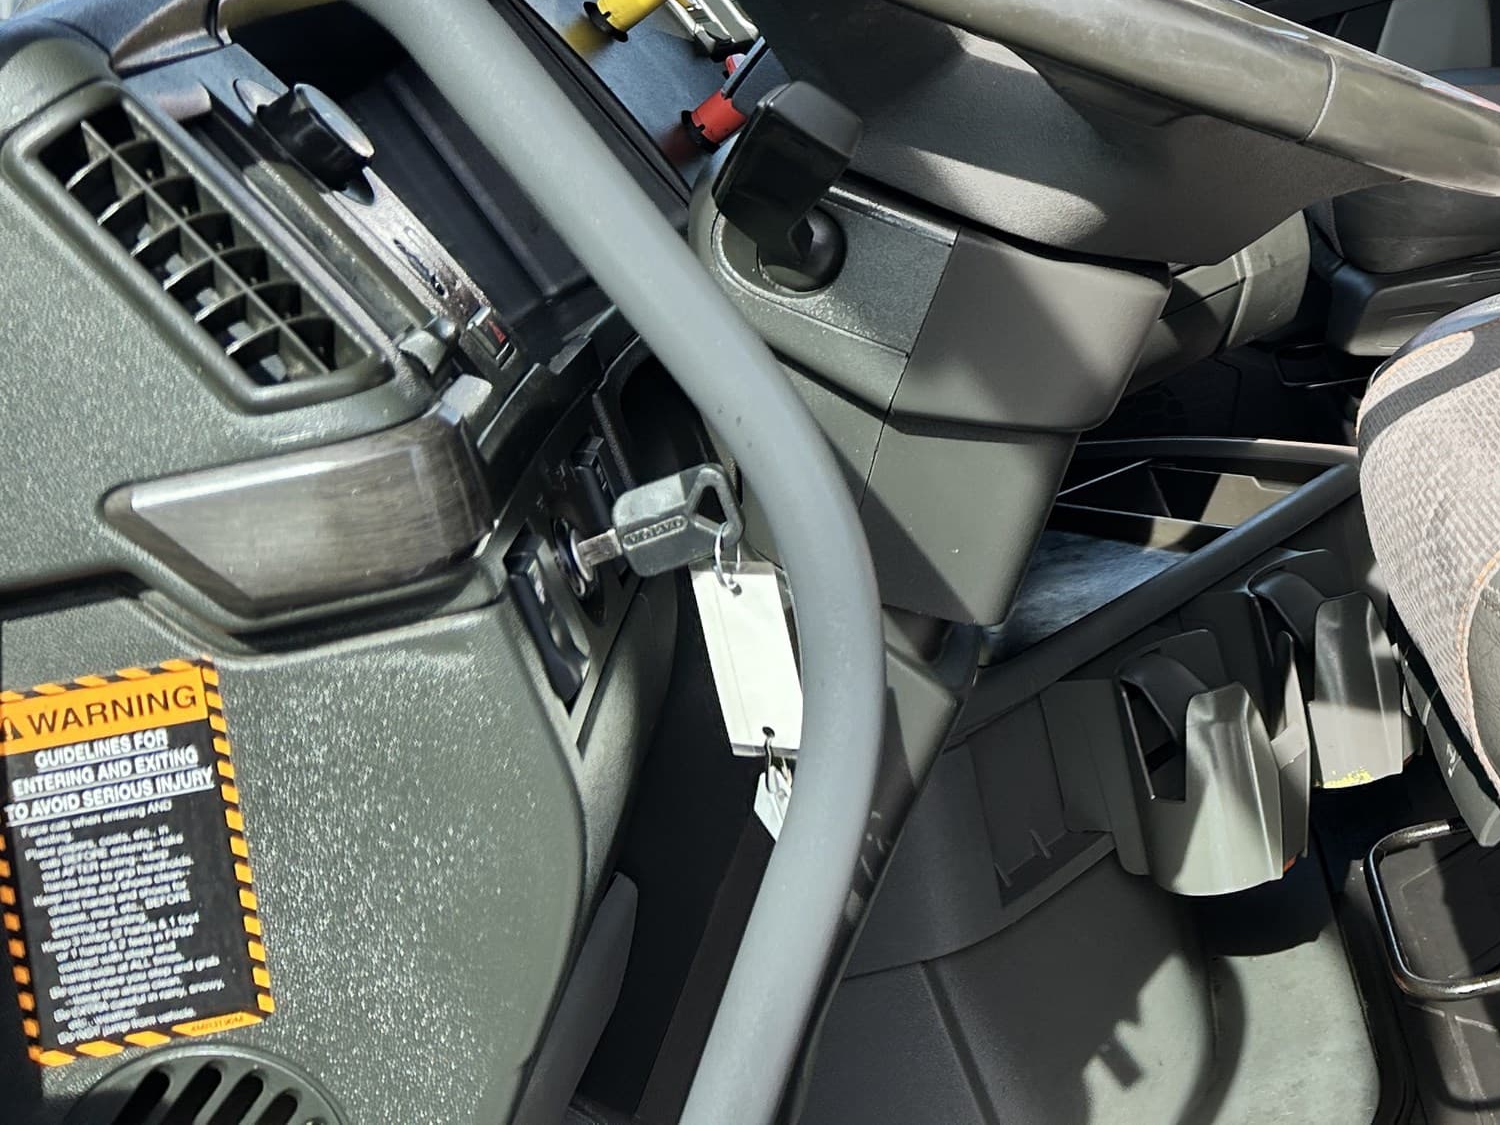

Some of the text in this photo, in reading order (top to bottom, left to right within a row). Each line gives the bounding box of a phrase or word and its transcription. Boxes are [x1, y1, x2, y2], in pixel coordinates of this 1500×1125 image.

[27, 684, 197, 735] WARNING
[12, 745, 199, 797] ENTERING AND EXITING
[35, 728, 168, 769] GUIDELINES FOR
[3, 764, 214, 822] TO AVOID SERIOUS INJURY
